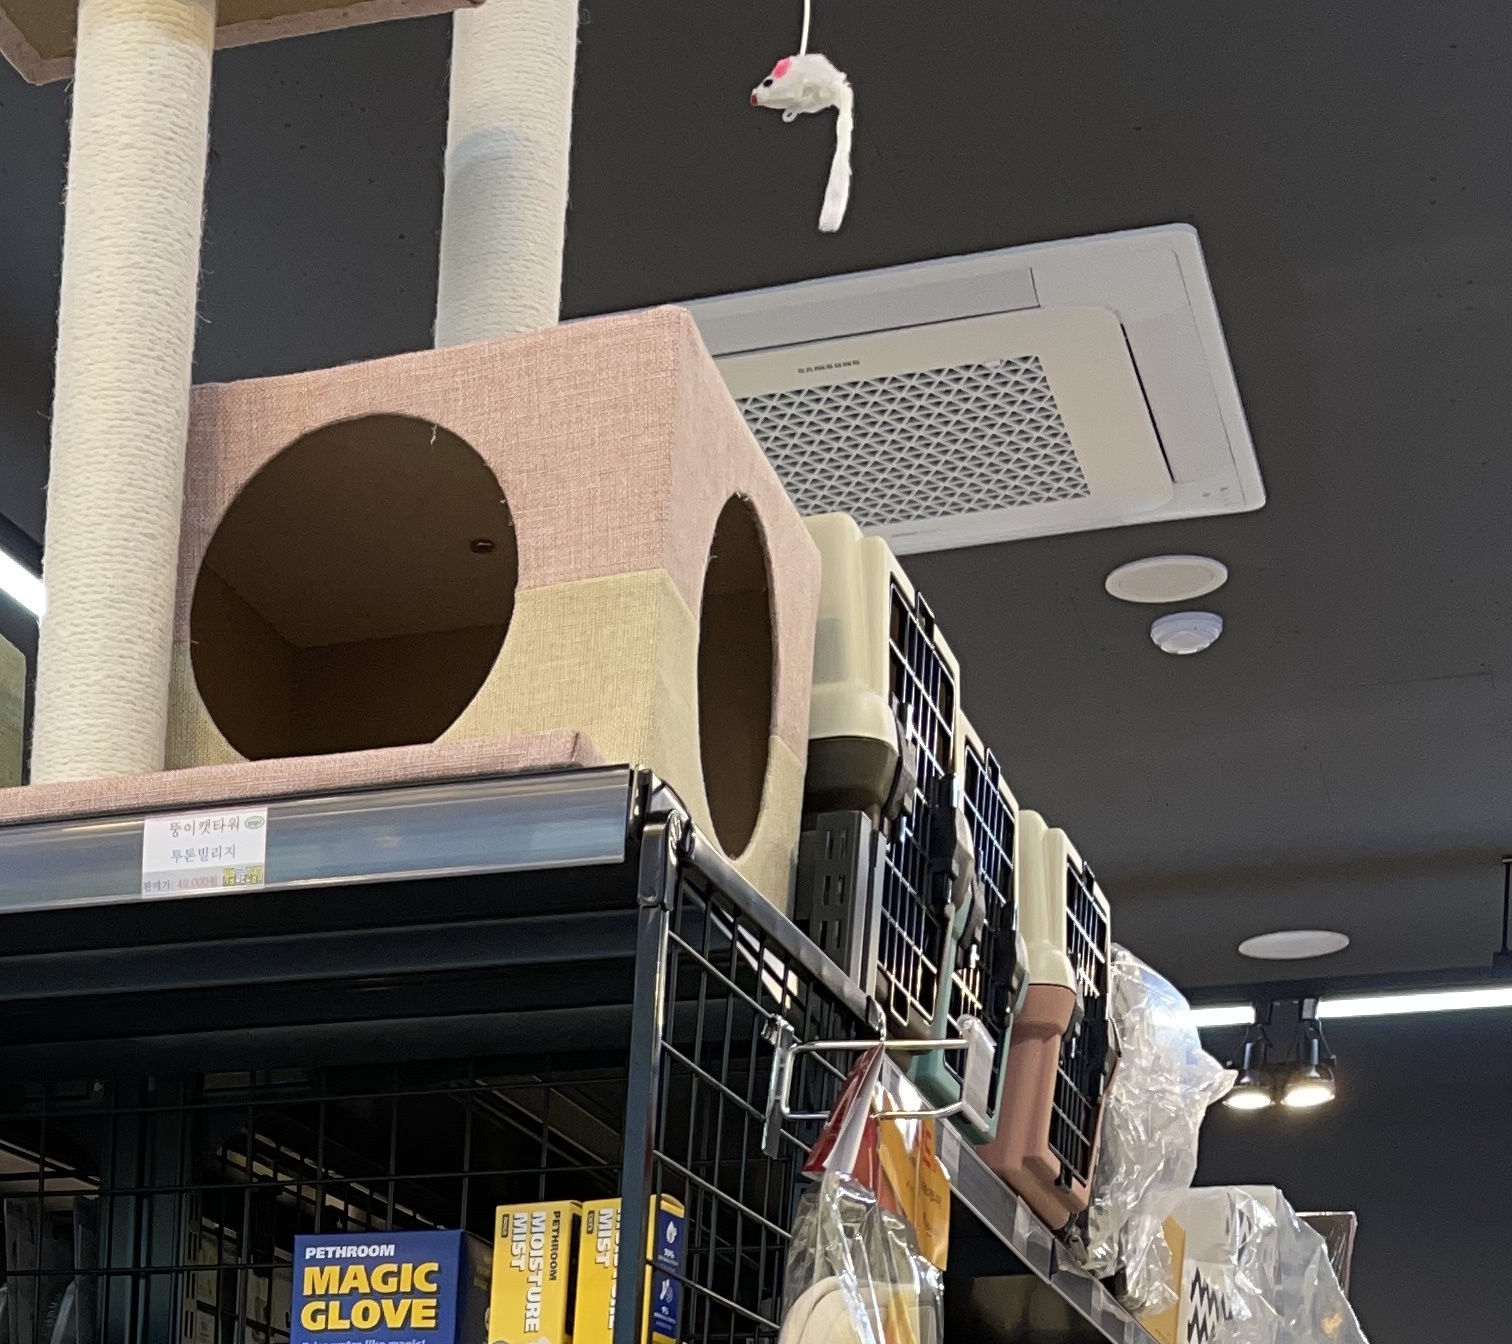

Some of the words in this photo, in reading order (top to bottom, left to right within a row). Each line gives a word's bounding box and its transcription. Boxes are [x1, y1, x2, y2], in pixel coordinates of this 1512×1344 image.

[305, 1245, 395, 1259] PETHROOM
[510, 1212, 529, 1271] MIST
[549, 1211, 561, 1281] PETHROOM
[596, 1208, 614, 1268] MIST
[303, 1263, 439, 1296] MAGIC
[525, 1211, 547, 1333] MOISTURE
[301, 1299, 437, 1330] GLOVE
